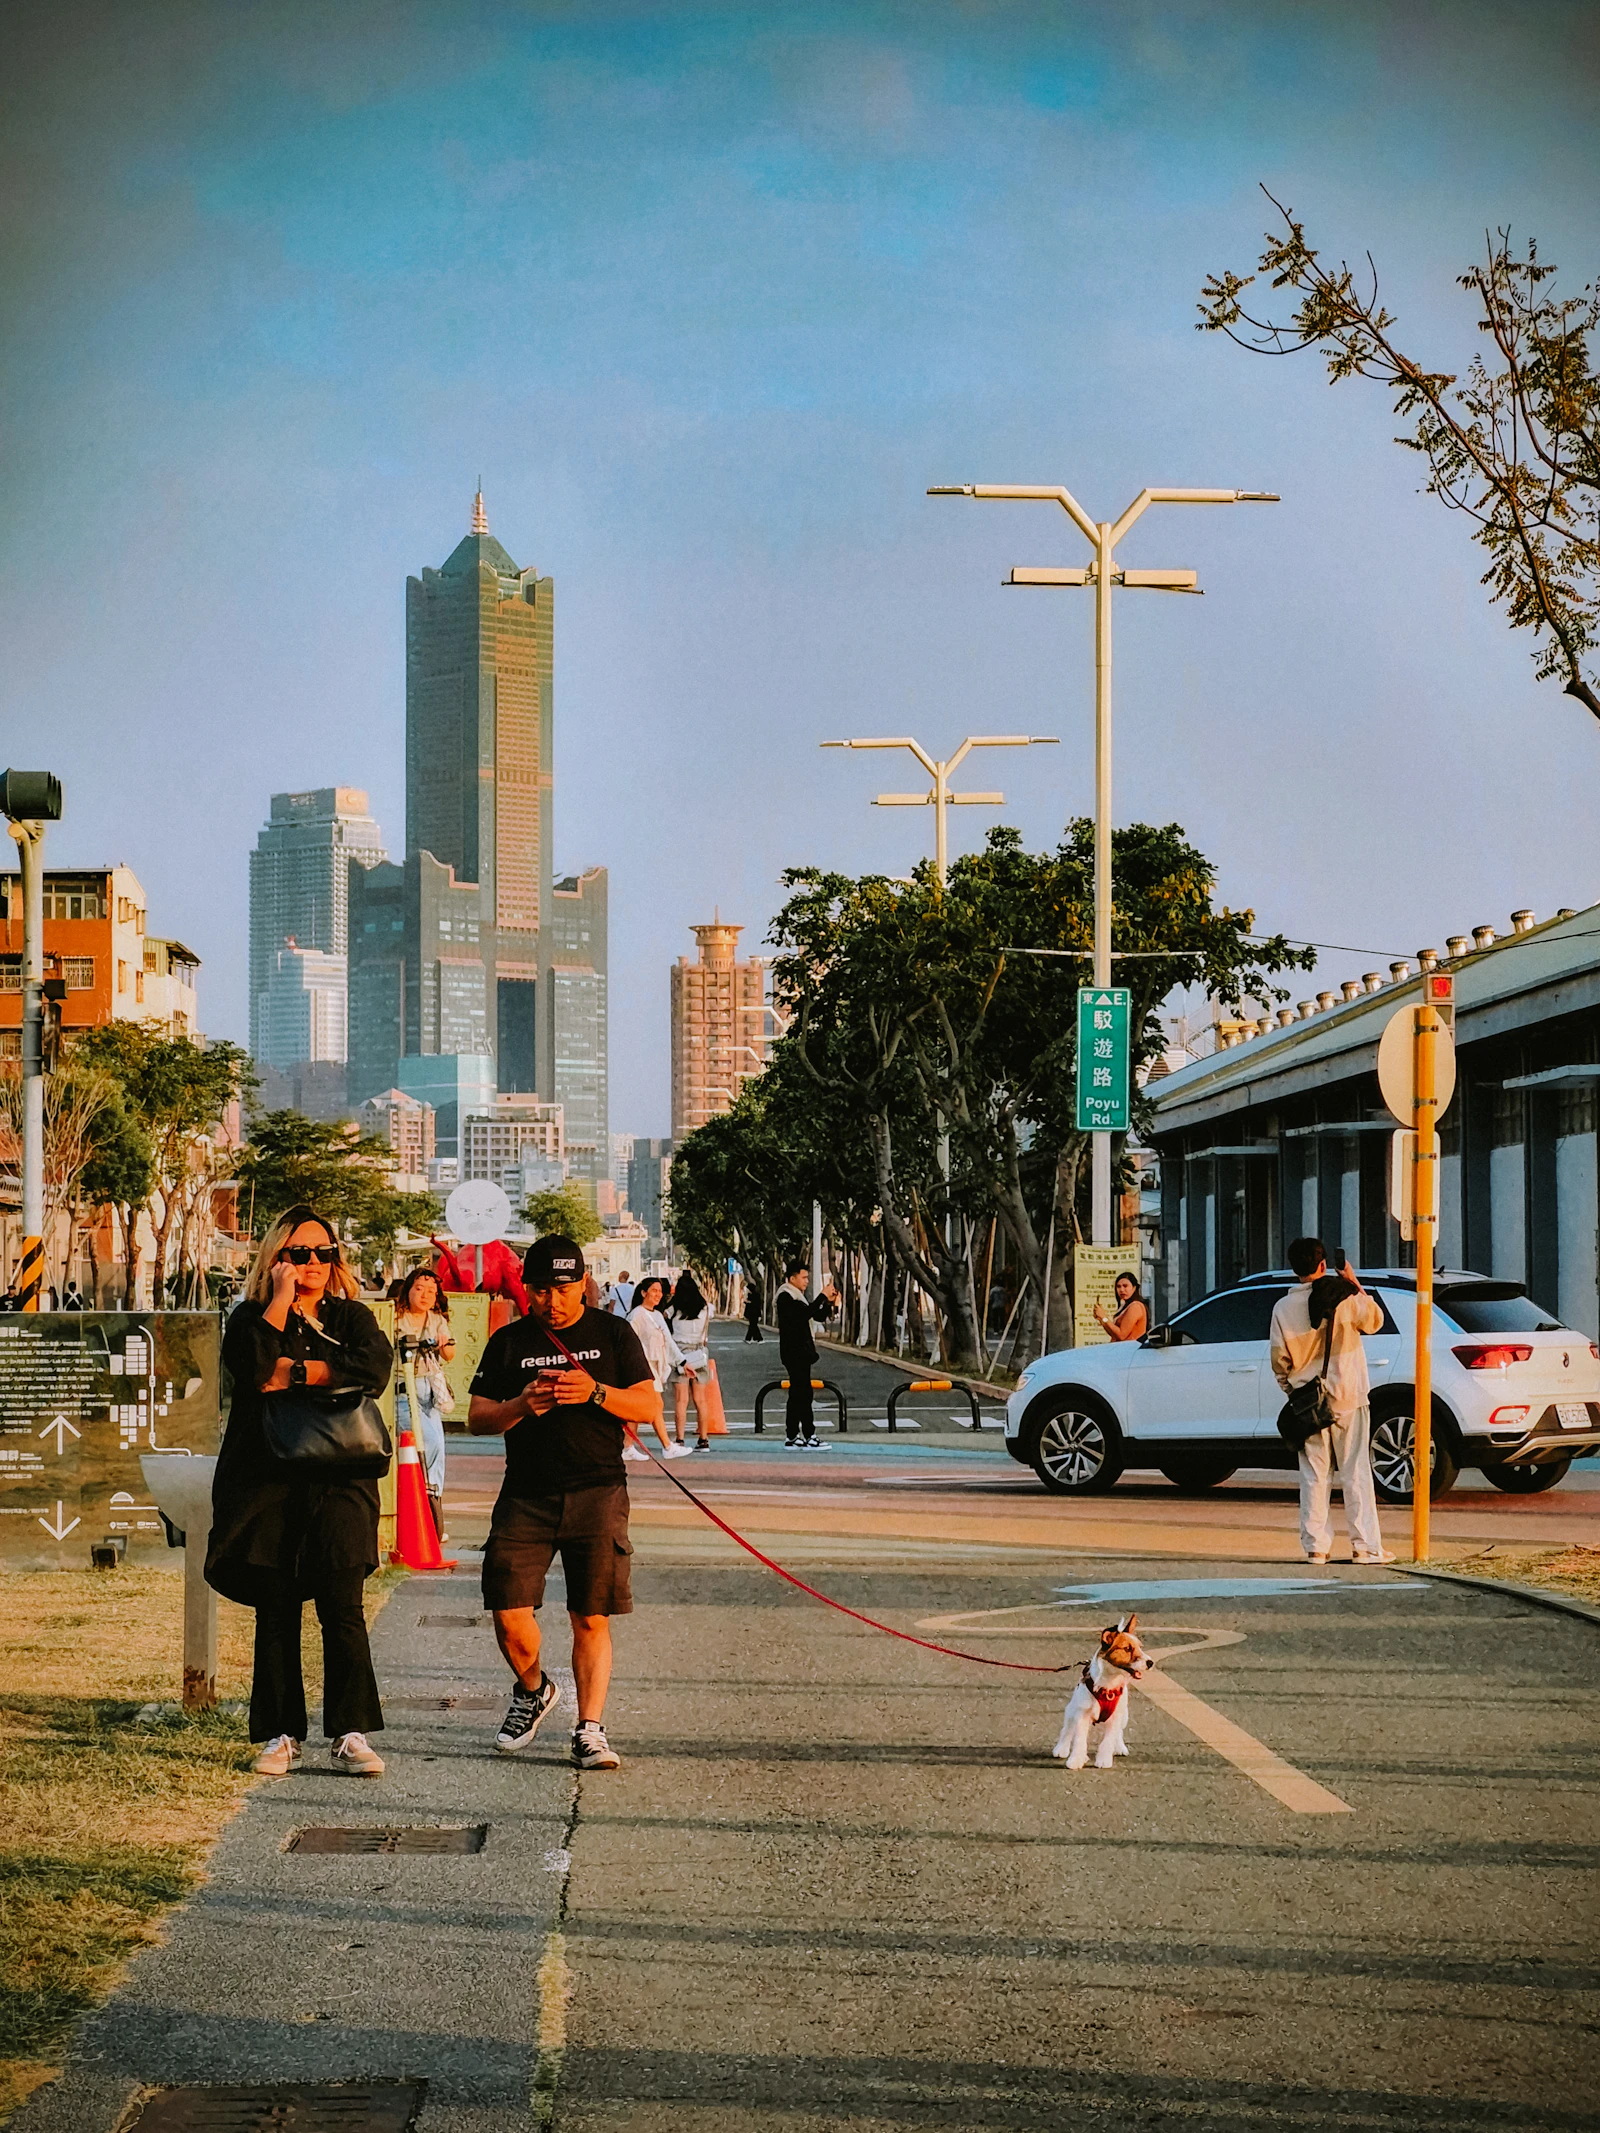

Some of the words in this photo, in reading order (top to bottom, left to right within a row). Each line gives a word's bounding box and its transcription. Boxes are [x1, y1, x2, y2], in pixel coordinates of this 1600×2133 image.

[1082, 992, 1094, 1005] 東
[1113, 992, 1127, 1006] E.
[1093, 1009, 1114, 1087] 駁遊路
[1085, 1096, 1120, 1112] Poyu
[1091, 1112, 1114, 1125] Rd.
